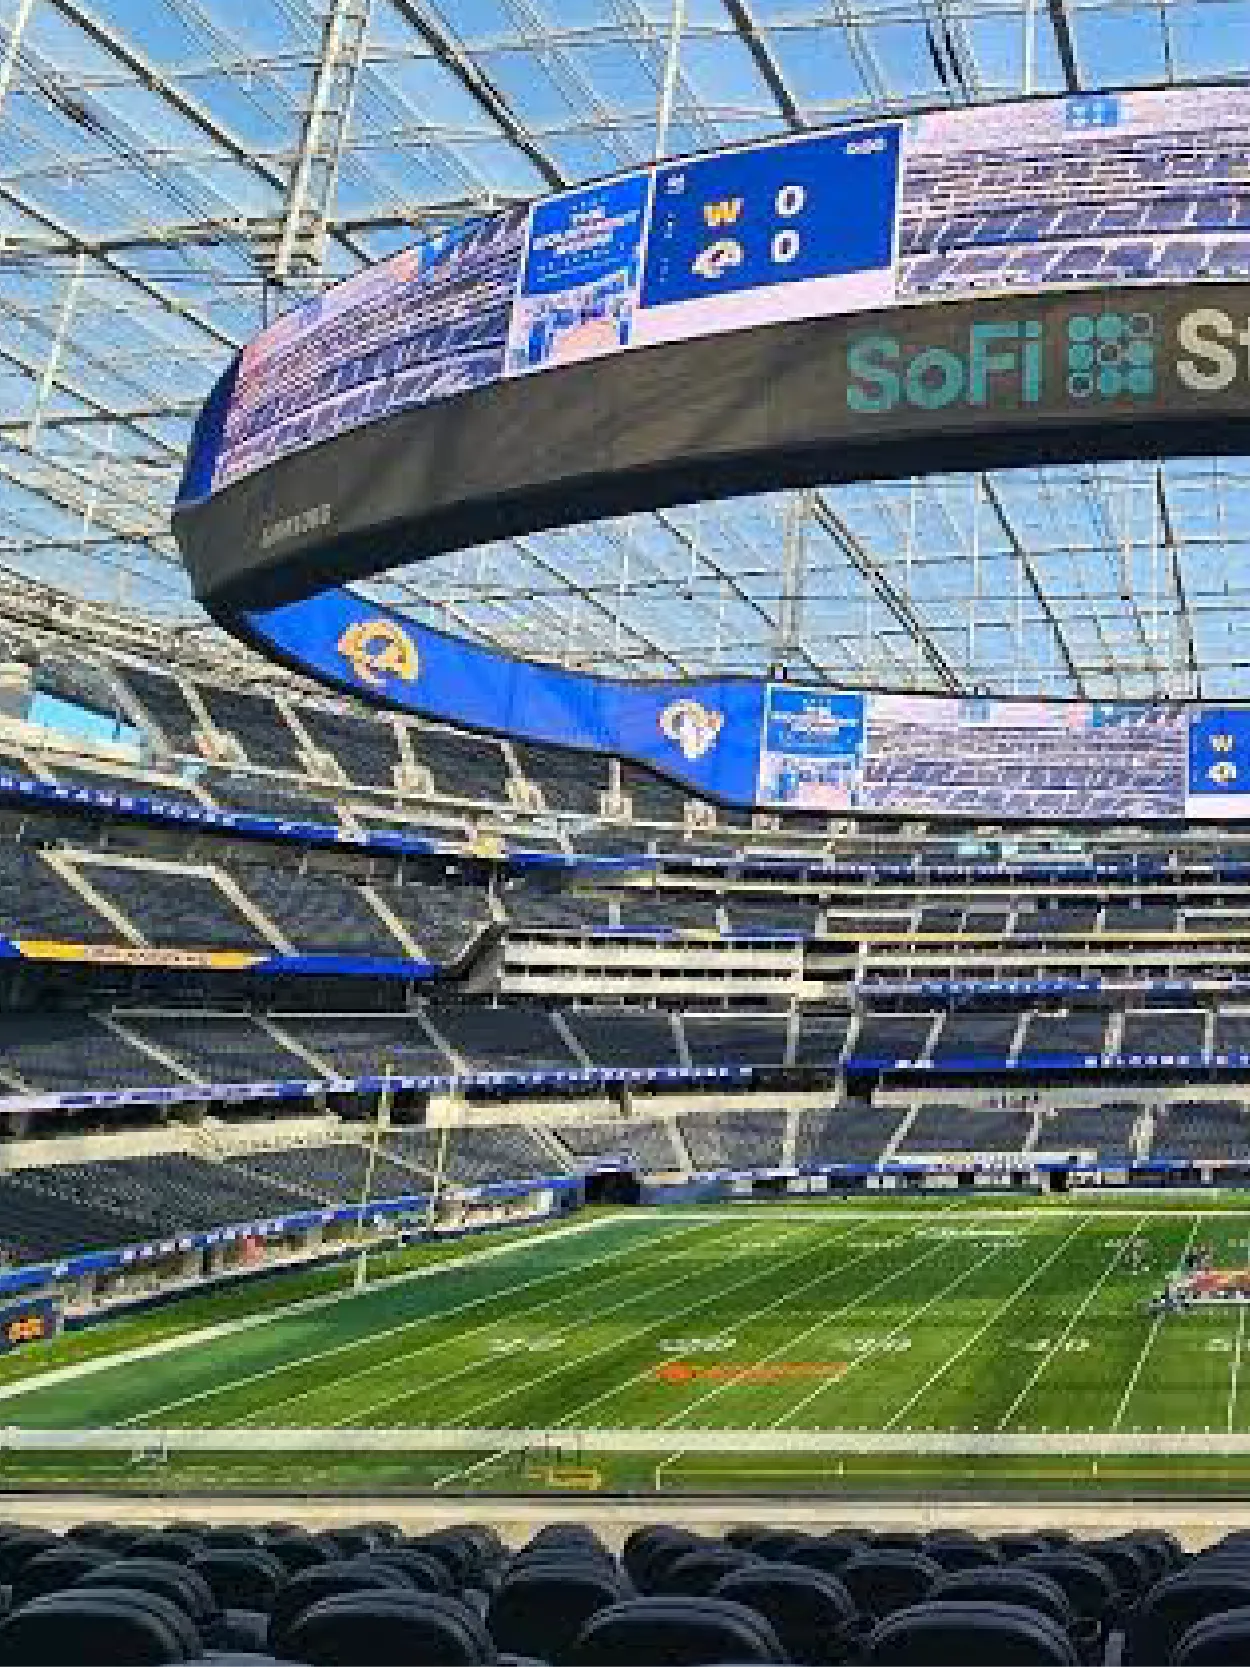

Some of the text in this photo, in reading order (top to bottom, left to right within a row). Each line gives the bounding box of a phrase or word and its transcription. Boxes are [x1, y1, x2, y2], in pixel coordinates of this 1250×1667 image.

[774, 185, 805, 217] 0
[770, 229, 801, 263] 0
[847, 320, 1041, 413] SoFi
